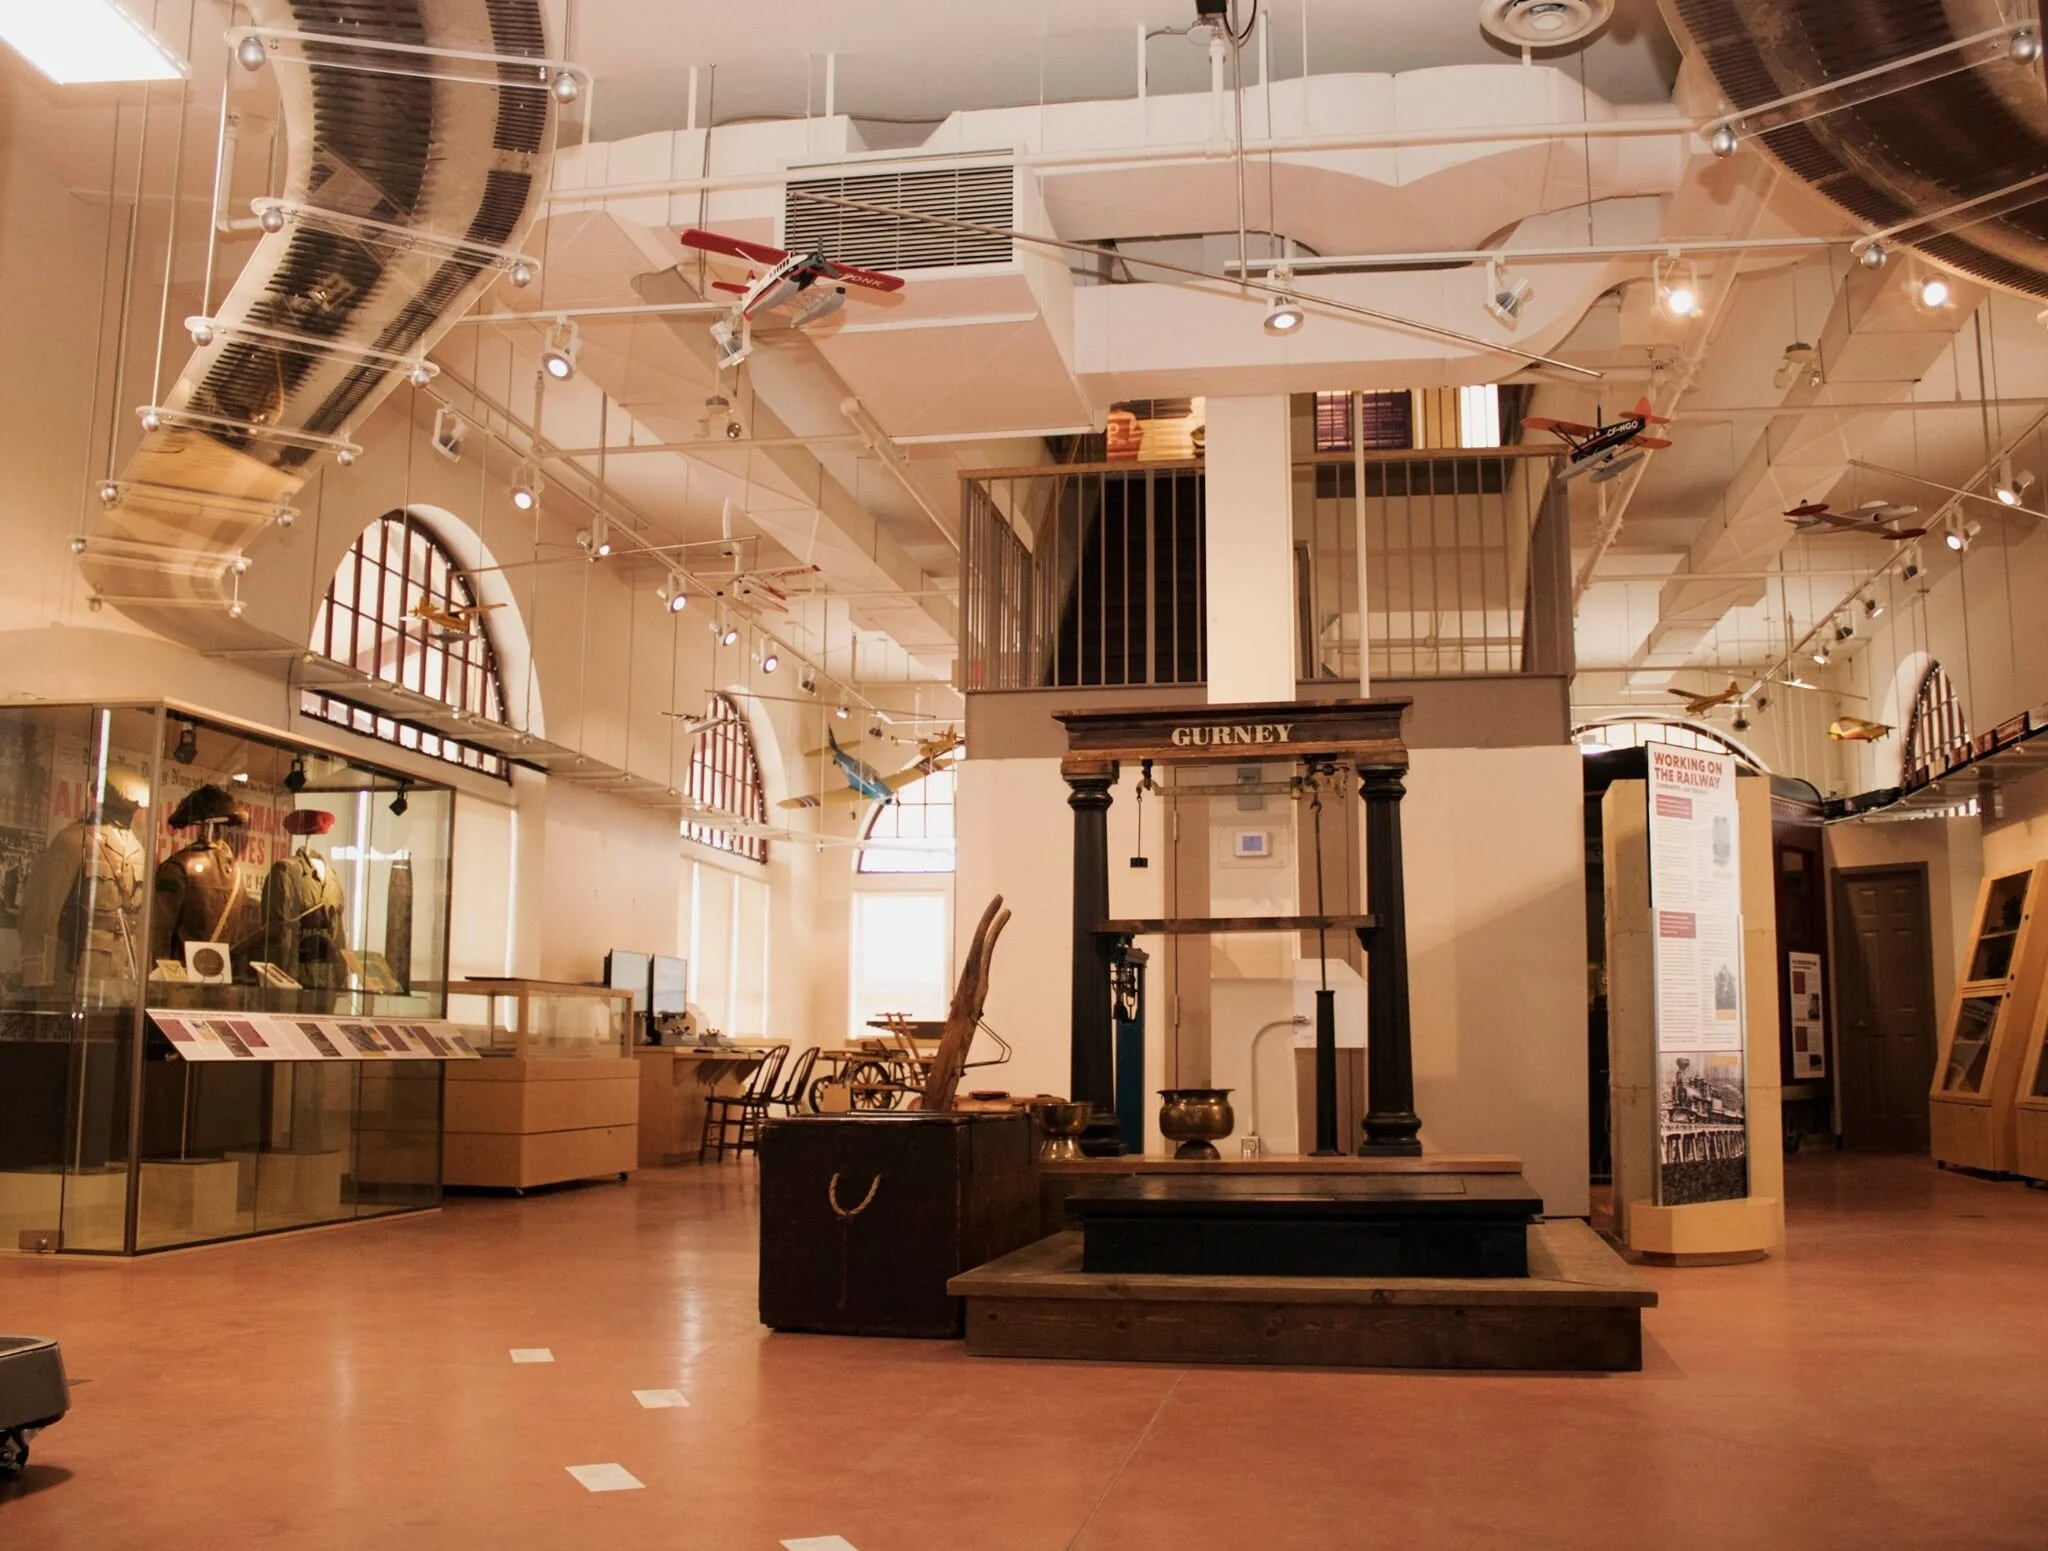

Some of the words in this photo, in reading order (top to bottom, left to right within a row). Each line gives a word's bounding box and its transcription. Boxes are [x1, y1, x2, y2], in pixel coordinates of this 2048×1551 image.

[1171, 723, 1293, 746] GURNEY
[1653, 752, 1705, 772] WORKING
[1707, 761, 1722, 775] ON
[1654, 767, 1675, 782] THE
[1677, 771, 1721, 789] RAILWAY
